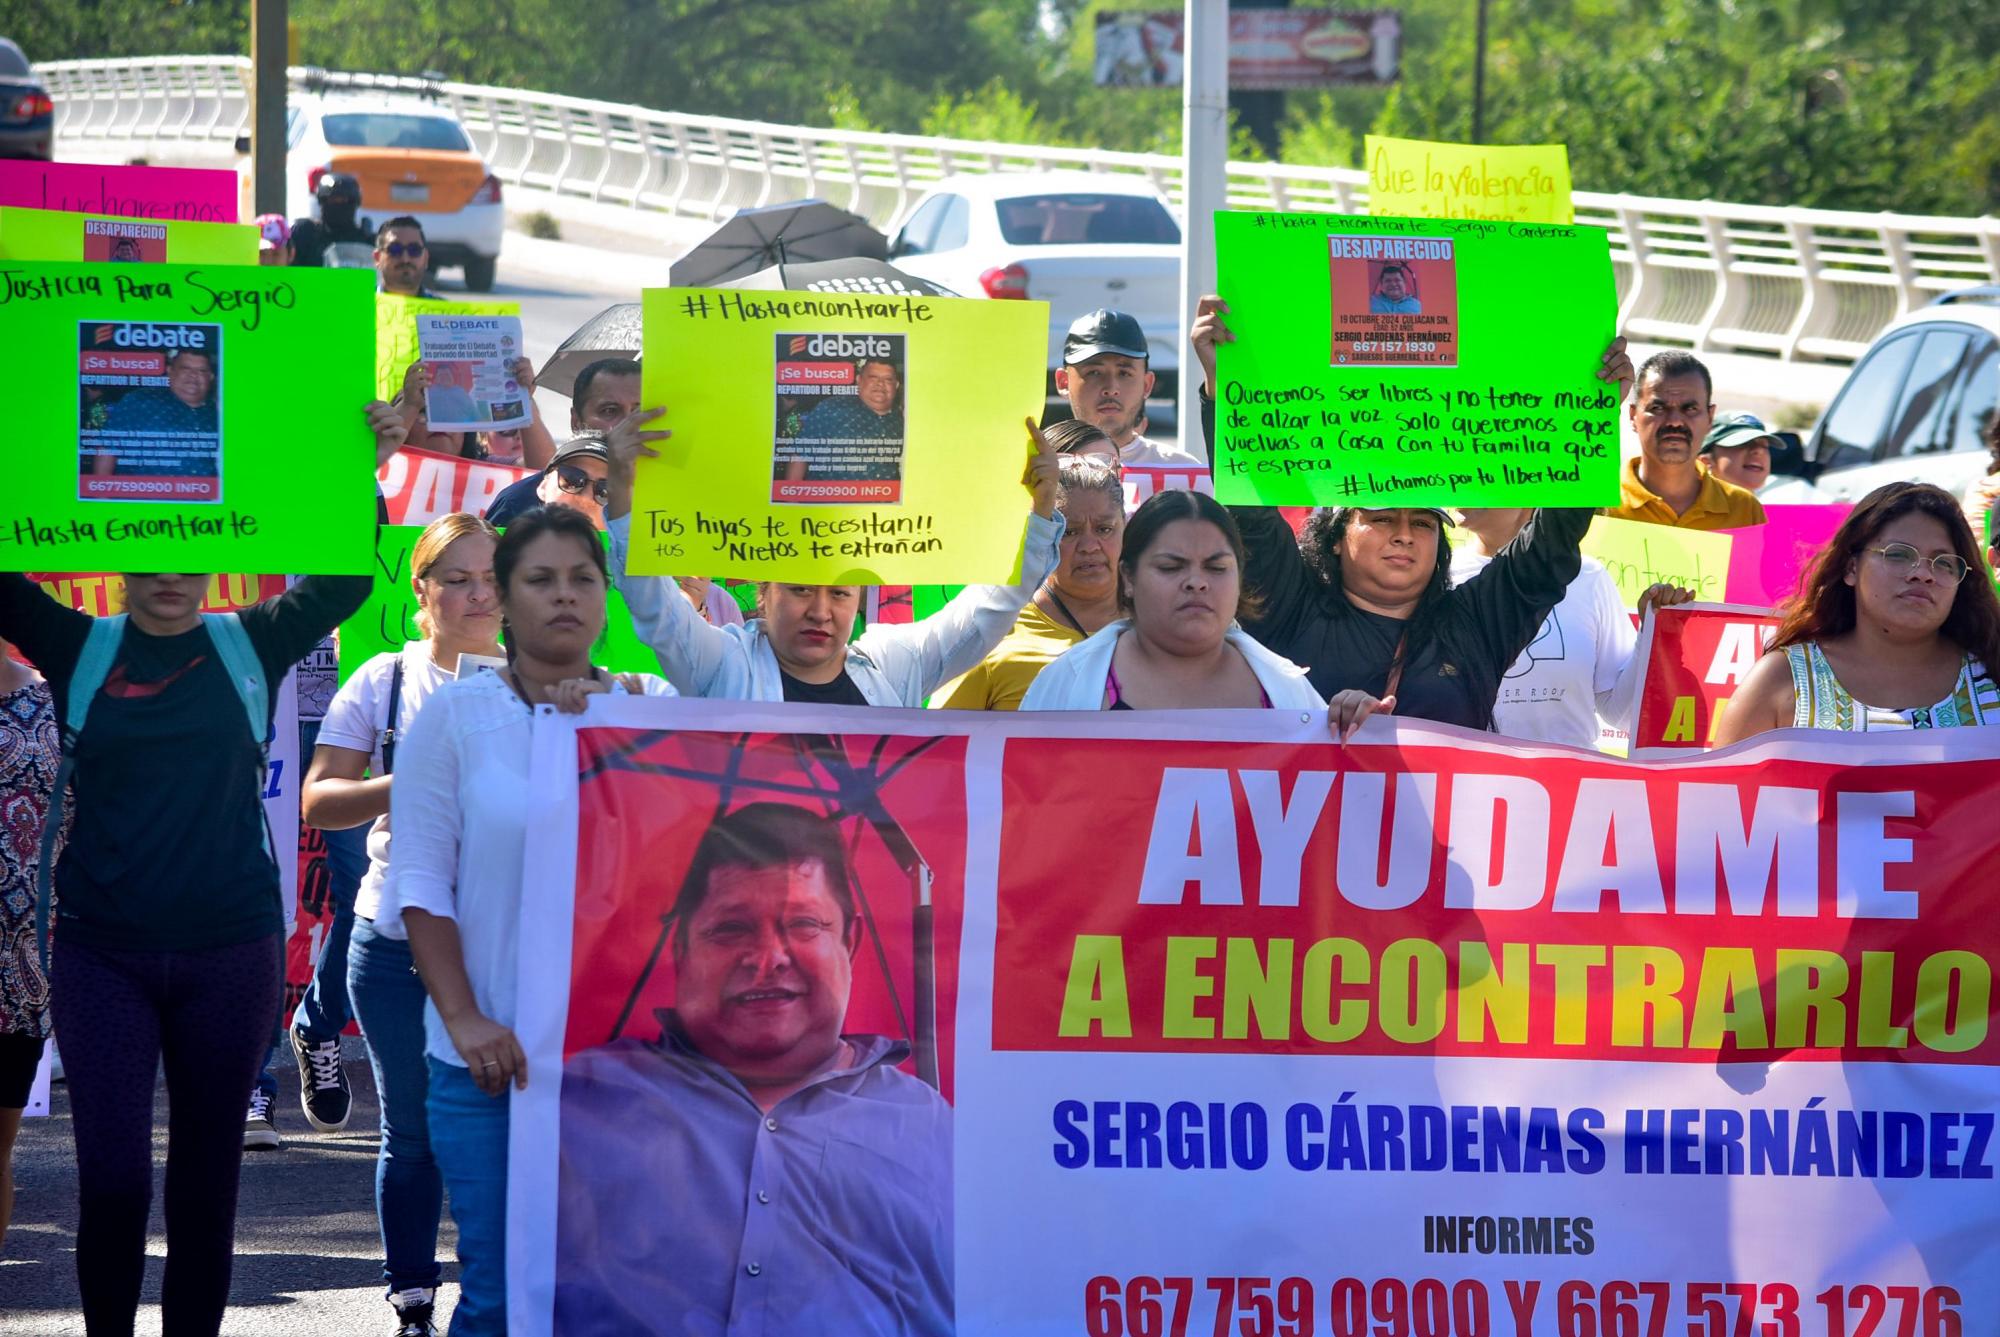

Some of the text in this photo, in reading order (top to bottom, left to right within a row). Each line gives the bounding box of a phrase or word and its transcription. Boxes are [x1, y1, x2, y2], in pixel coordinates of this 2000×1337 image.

[1424, 152, 1445, 193] la
[86, 221, 166, 240] DESAPARECIDO
[1331, 239, 1452, 260] DESAPARECIDO
[185, 271, 296, 331] Sergio
[114, 323, 206, 348] debate
[450, 320, 499, 329] DEBATE
[1334, 332, 1362, 342] SERGIO
[808, 333, 891, 357] debate
[1353, 342, 1436, 352] 667 157 1930
[85, 356, 160, 370] ¡Se busca!
[781, 367, 849, 379] ¡Se busca!
[777, 385, 860, 396] REPARTIDOR DE DEBATE
[1225, 381, 1325, 405] Queremos
[1380, 383, 1433, 402] libres
[1457, 390, 1480, 408] no
[1227, 409, 1251, 428] de
[1261, 408, 1311, 430] alzar
[1321, 410, 1341, 427] la
[1452, 416, 1557, 436] queremos
[1572, 419, 1613, 442] que
[1310, 436, 1323, 450] a
[1440, 436, 1464, 453] tu
[1564, 441, 1608, 462] que
[1224, 457, 1332, 476] te espera
[88, 481, 210, 494] 6677590900 INFO
[780, 486, 892, 496] 6677590900 INFO
[0, 511, 260, 547] Hasta Encontrarte
[645, 511, 685, 538] Tus
[696, 511, 752, 550] hijas
[761, 516, 790, 538] te
[654, 542, 685, 557] tus
[809, 541, 834, 558] te
[1662, 696, 1696, 742] A
[1137, 767, 1919, 919] AYUDAME
[1057, 934, 1994, 1052] A ENCONTRARLO
[1052, 1092, 1994, 1179] SERGIO CÁRDENAS HERNÁNDEZ
[1423, 1215, 1596, 1256] INFORMES
[1085, 1276, 1963, 1337] 667 759 0900 Y 667 573 1276
